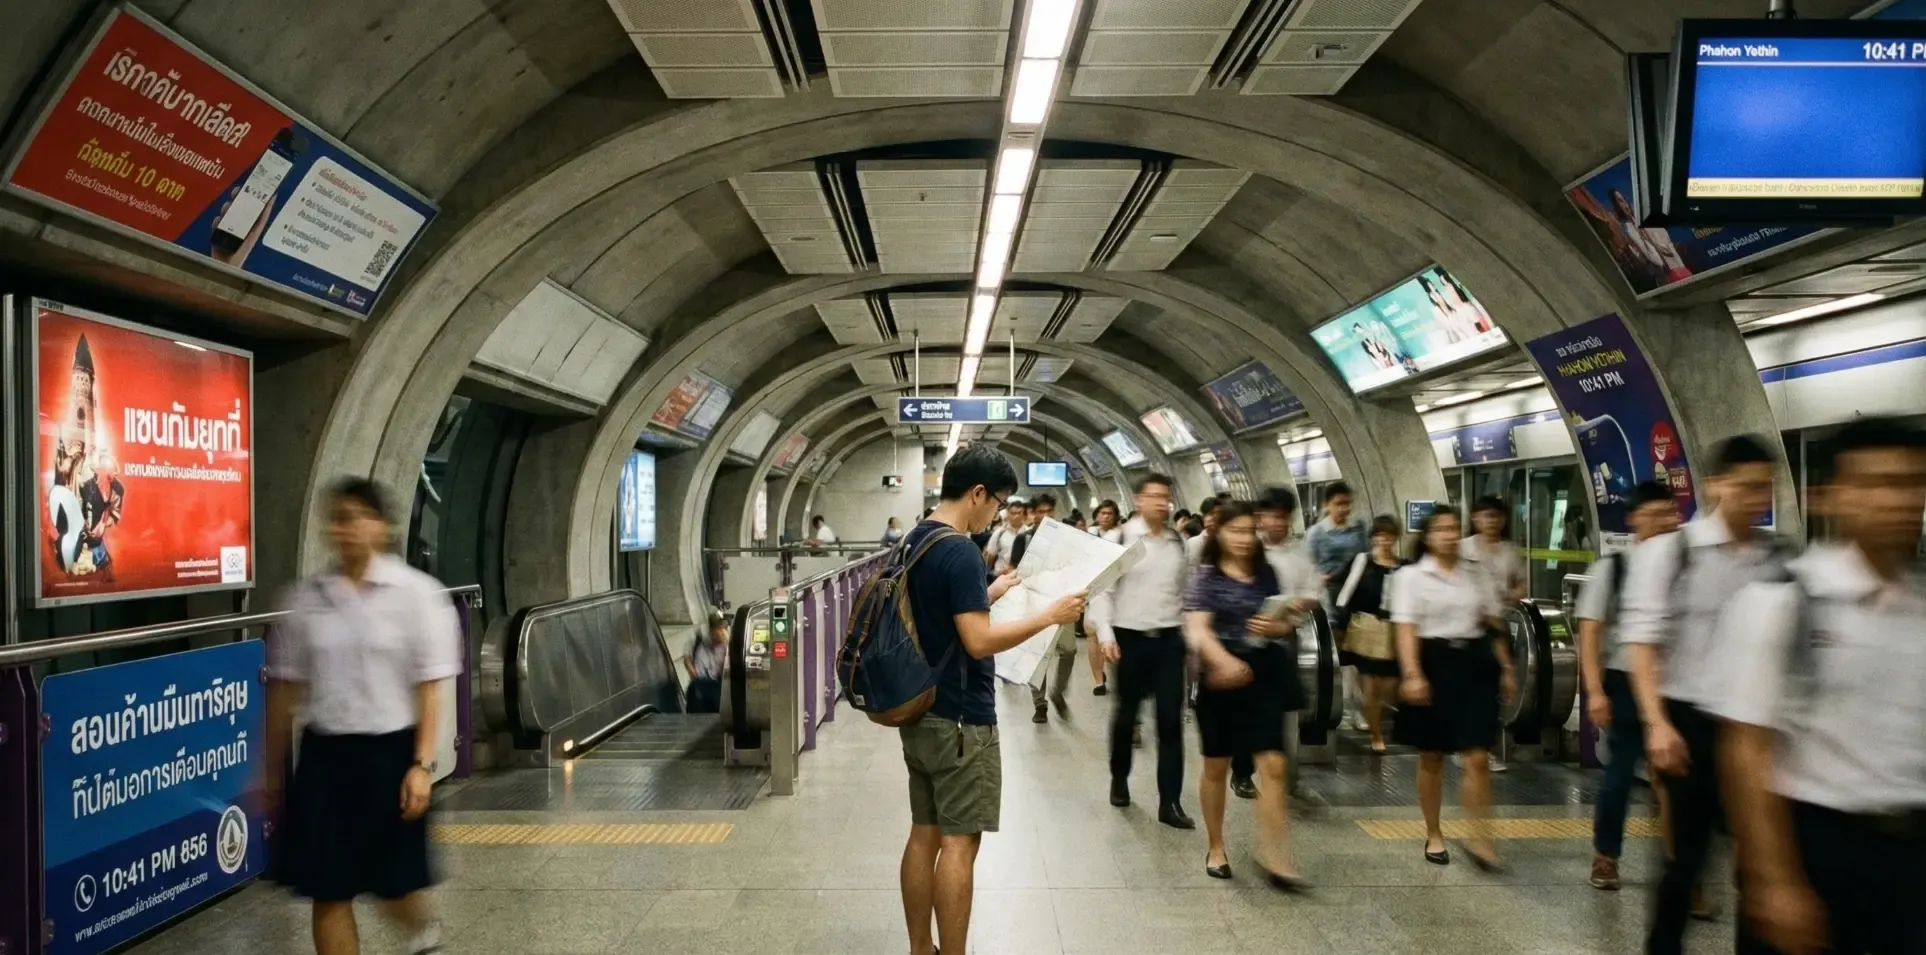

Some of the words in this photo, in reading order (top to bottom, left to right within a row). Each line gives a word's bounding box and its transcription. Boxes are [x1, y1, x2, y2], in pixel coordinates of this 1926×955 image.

[1863, 42, 1906, 60] 10:41
[1912, 42, 1926, 60] P
[134, 166, 156, 187] 10
[1603, 370, 1625, 388] PM
[102, 857, 145, 897] 10:41
[151, 844, 175, 878] PM
[180, 832, 208, 864] 856
